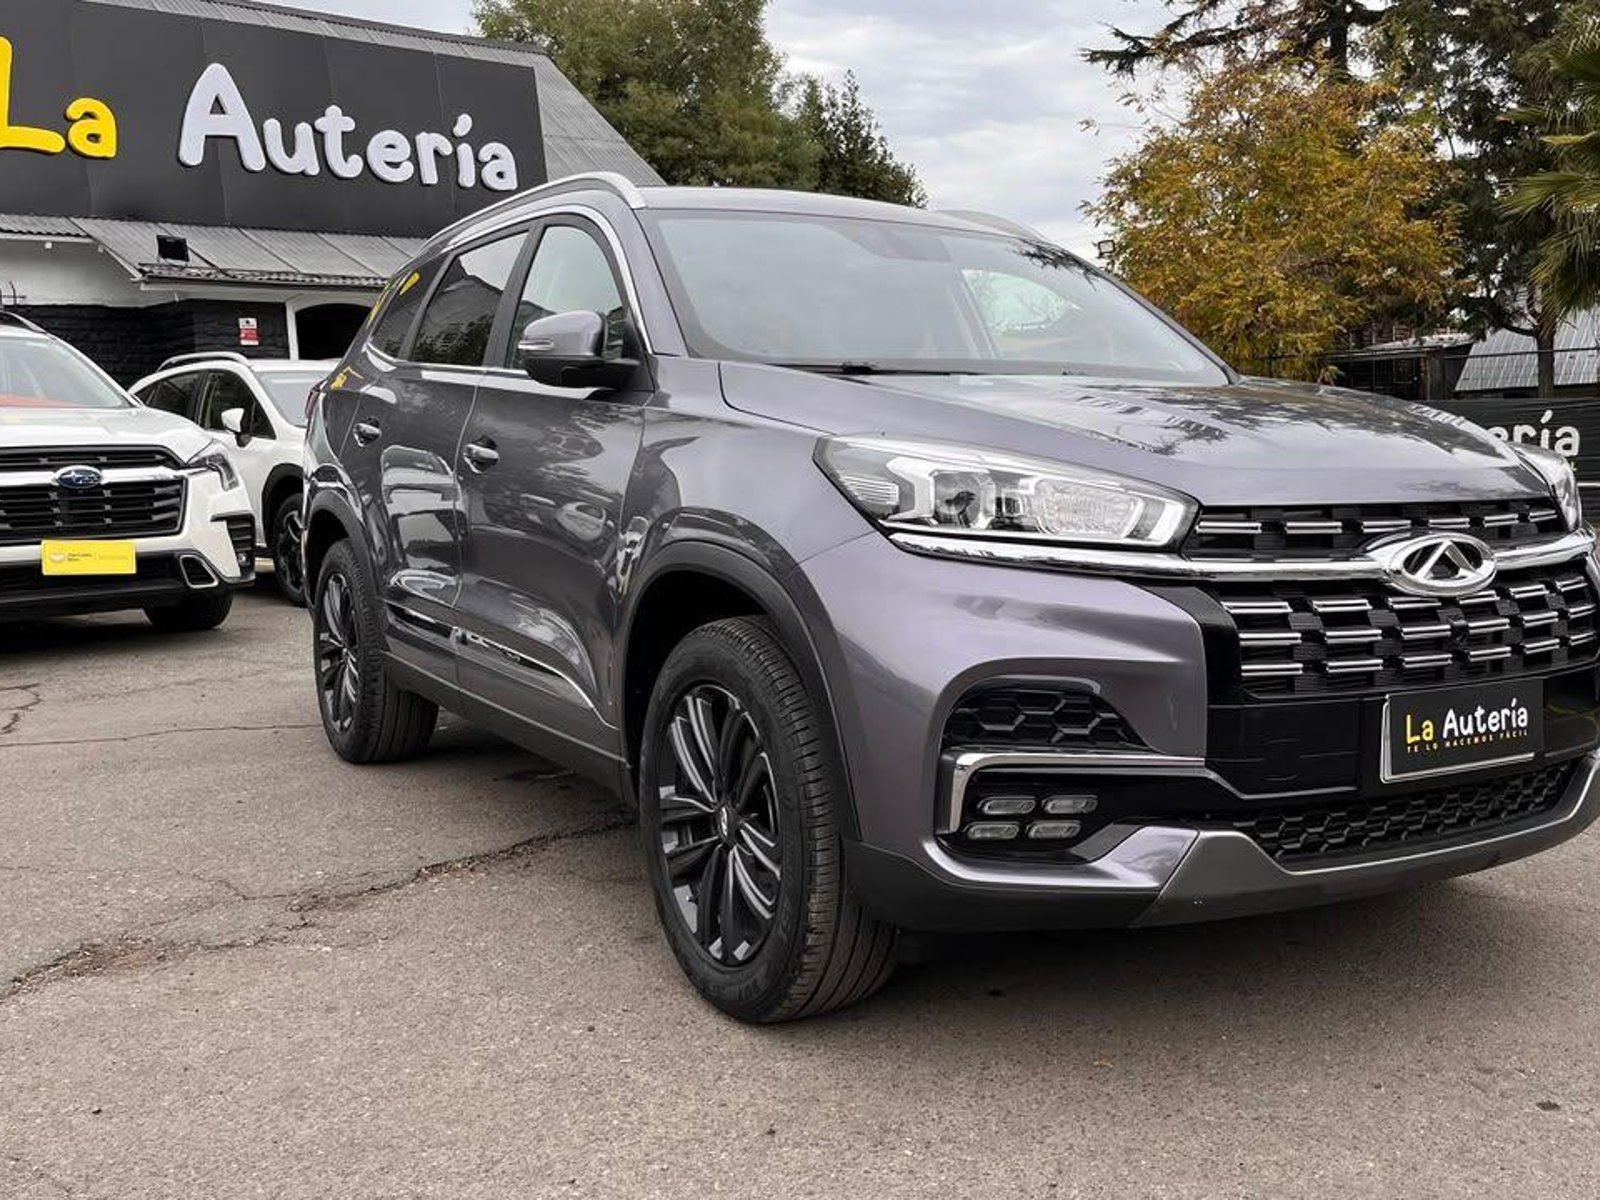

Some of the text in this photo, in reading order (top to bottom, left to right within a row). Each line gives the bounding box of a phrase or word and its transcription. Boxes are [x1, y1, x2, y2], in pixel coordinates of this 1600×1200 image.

[0, 36, 519, 191] La Autería
[1405, 697, 1528, 744] La Autería
